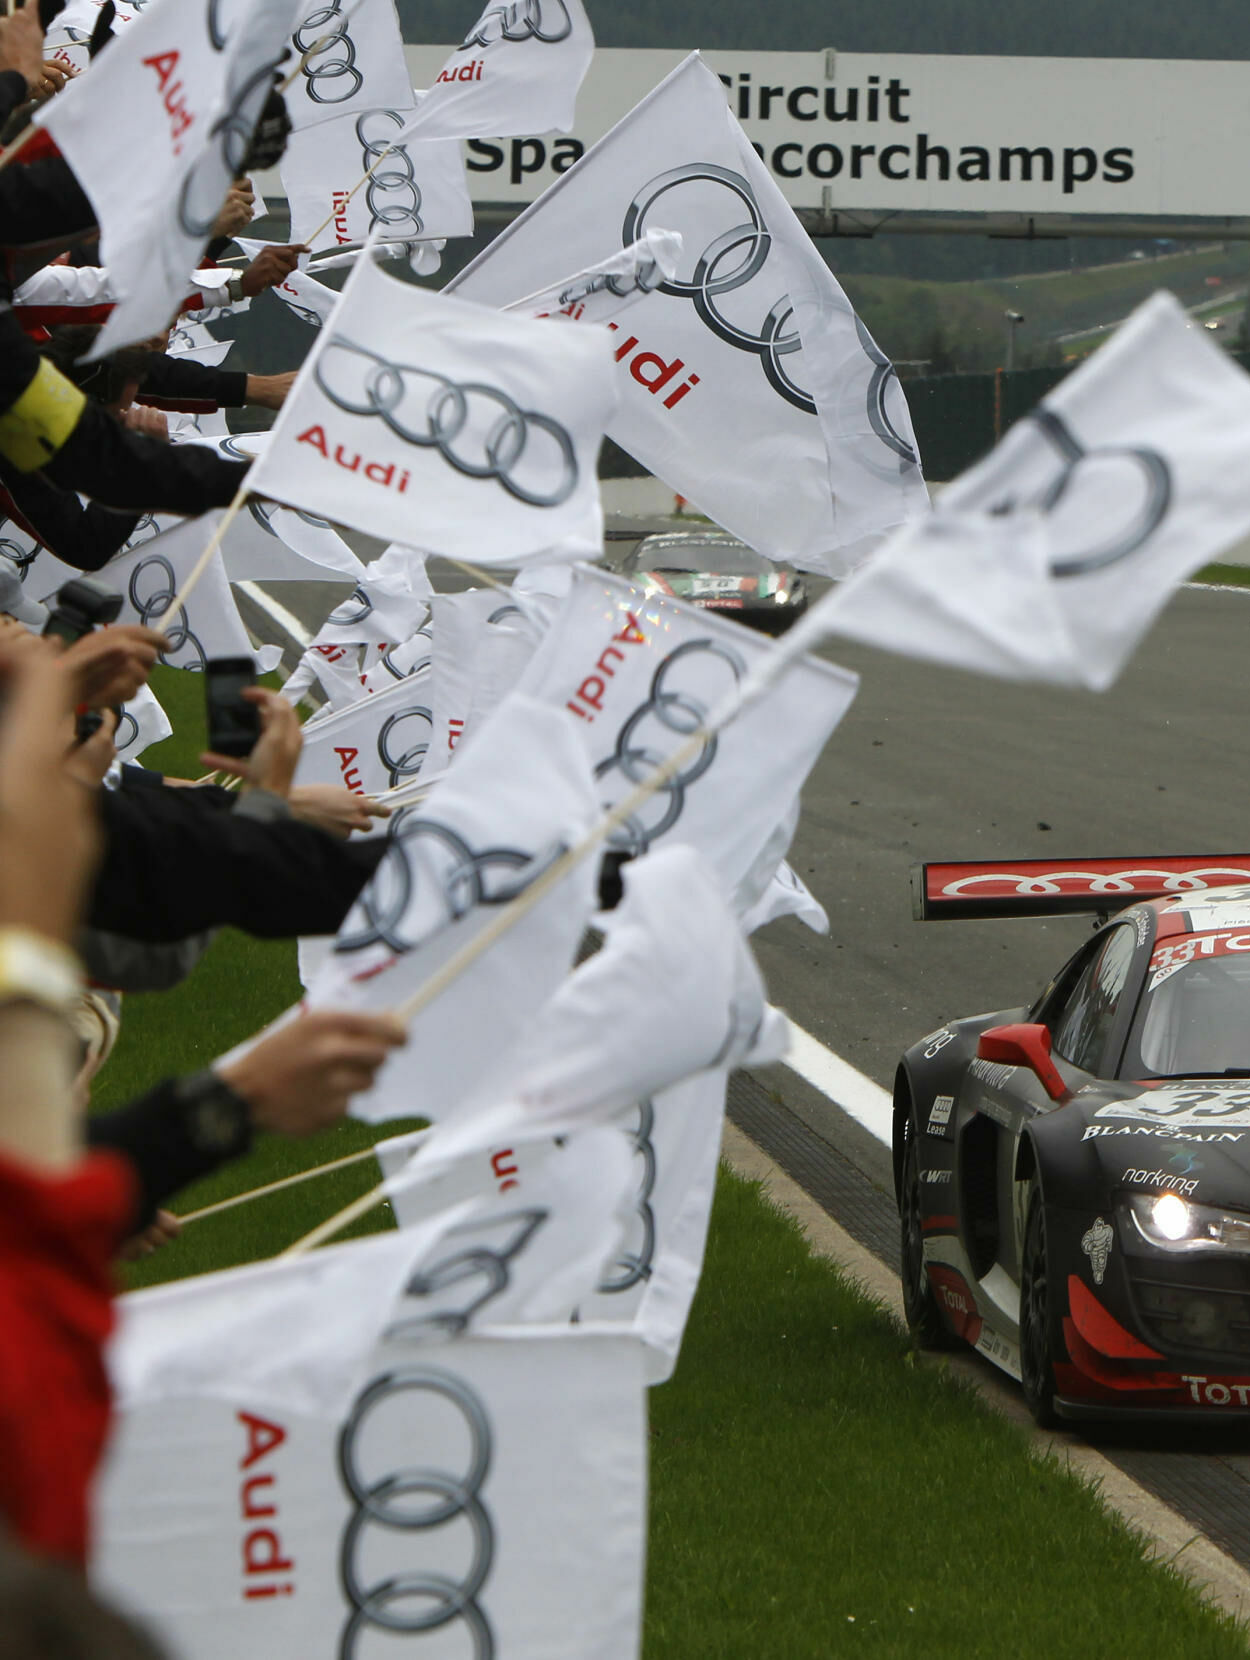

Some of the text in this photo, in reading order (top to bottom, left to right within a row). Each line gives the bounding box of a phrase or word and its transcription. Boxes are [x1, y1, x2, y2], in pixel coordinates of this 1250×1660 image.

[717, 73, 910, 122] ircuit
[466, 133, 1135, 194] Spa corchamps
[607, 322, 700, 410] di
[297, 424, 410, 493] Audi
[566, 612, 644, 722] Audi
[1149, 942, 1196, 971] 33
[1080, 1124, 1247, 1142] BLANCPAIN
[237, 1411, 293, 1599] Audi
